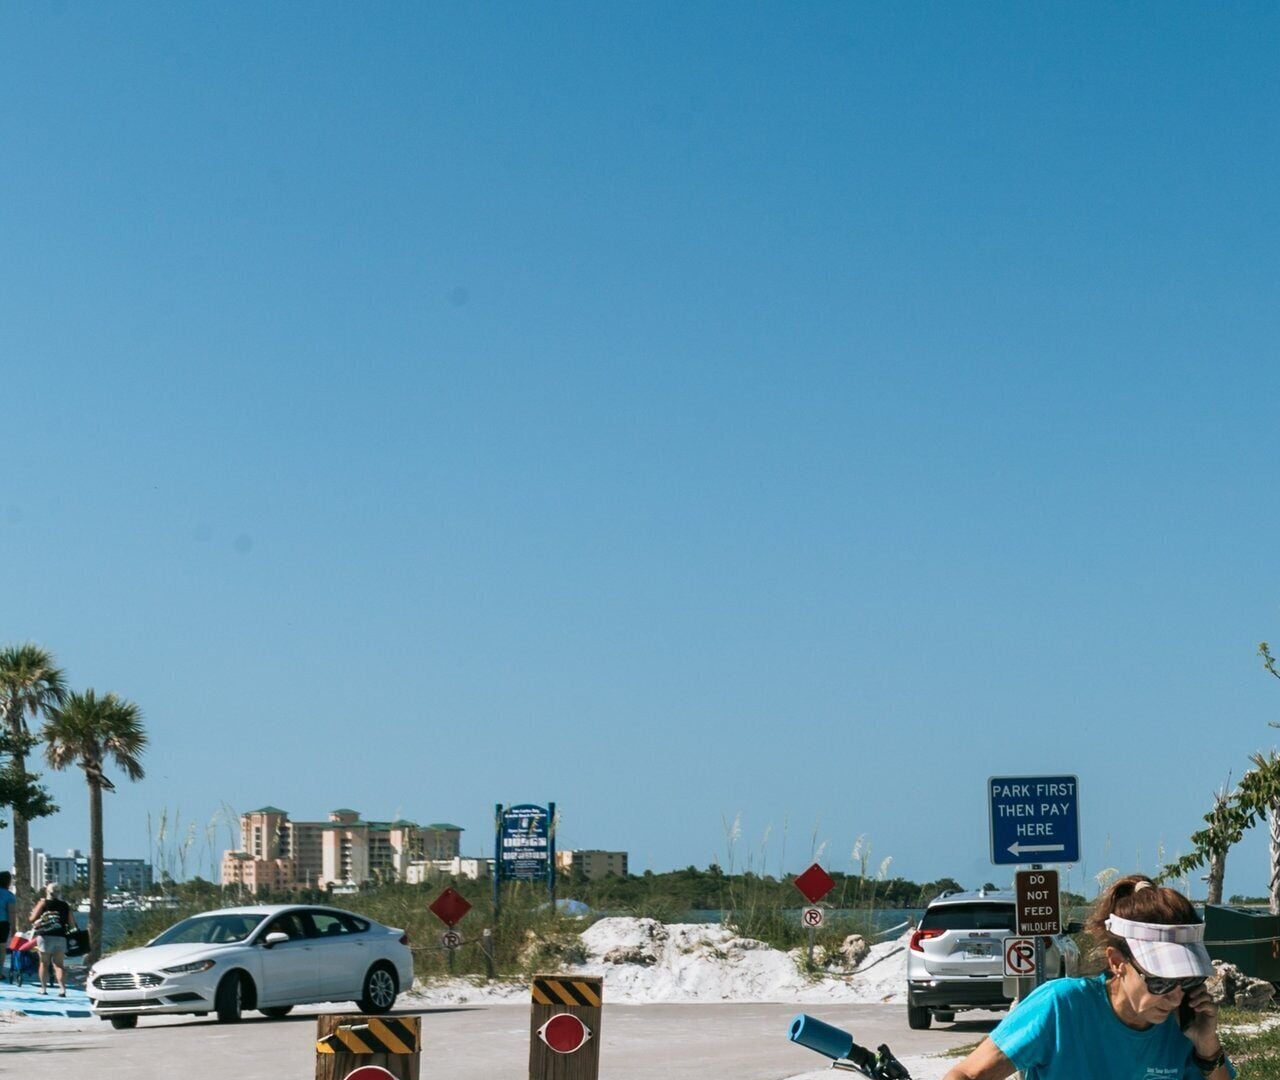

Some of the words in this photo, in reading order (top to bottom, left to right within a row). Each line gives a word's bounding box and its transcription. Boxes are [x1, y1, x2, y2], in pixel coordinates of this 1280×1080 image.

[992, 784, 1030, 798] PARK
[1036, 783, 1075, 797] FIRST
[998, 804, 1035, 817] THEN
[1040, 803, 1070, 816] PAY
[1016, 823, 1054, 836] HERE
[1029, 875, 1045, 885] DO
[1027, 891, 1049, 900] NOT
[1024, 906, 1053, 916] FEED
[1020, 921, 1058, 932] WILDLIFE
